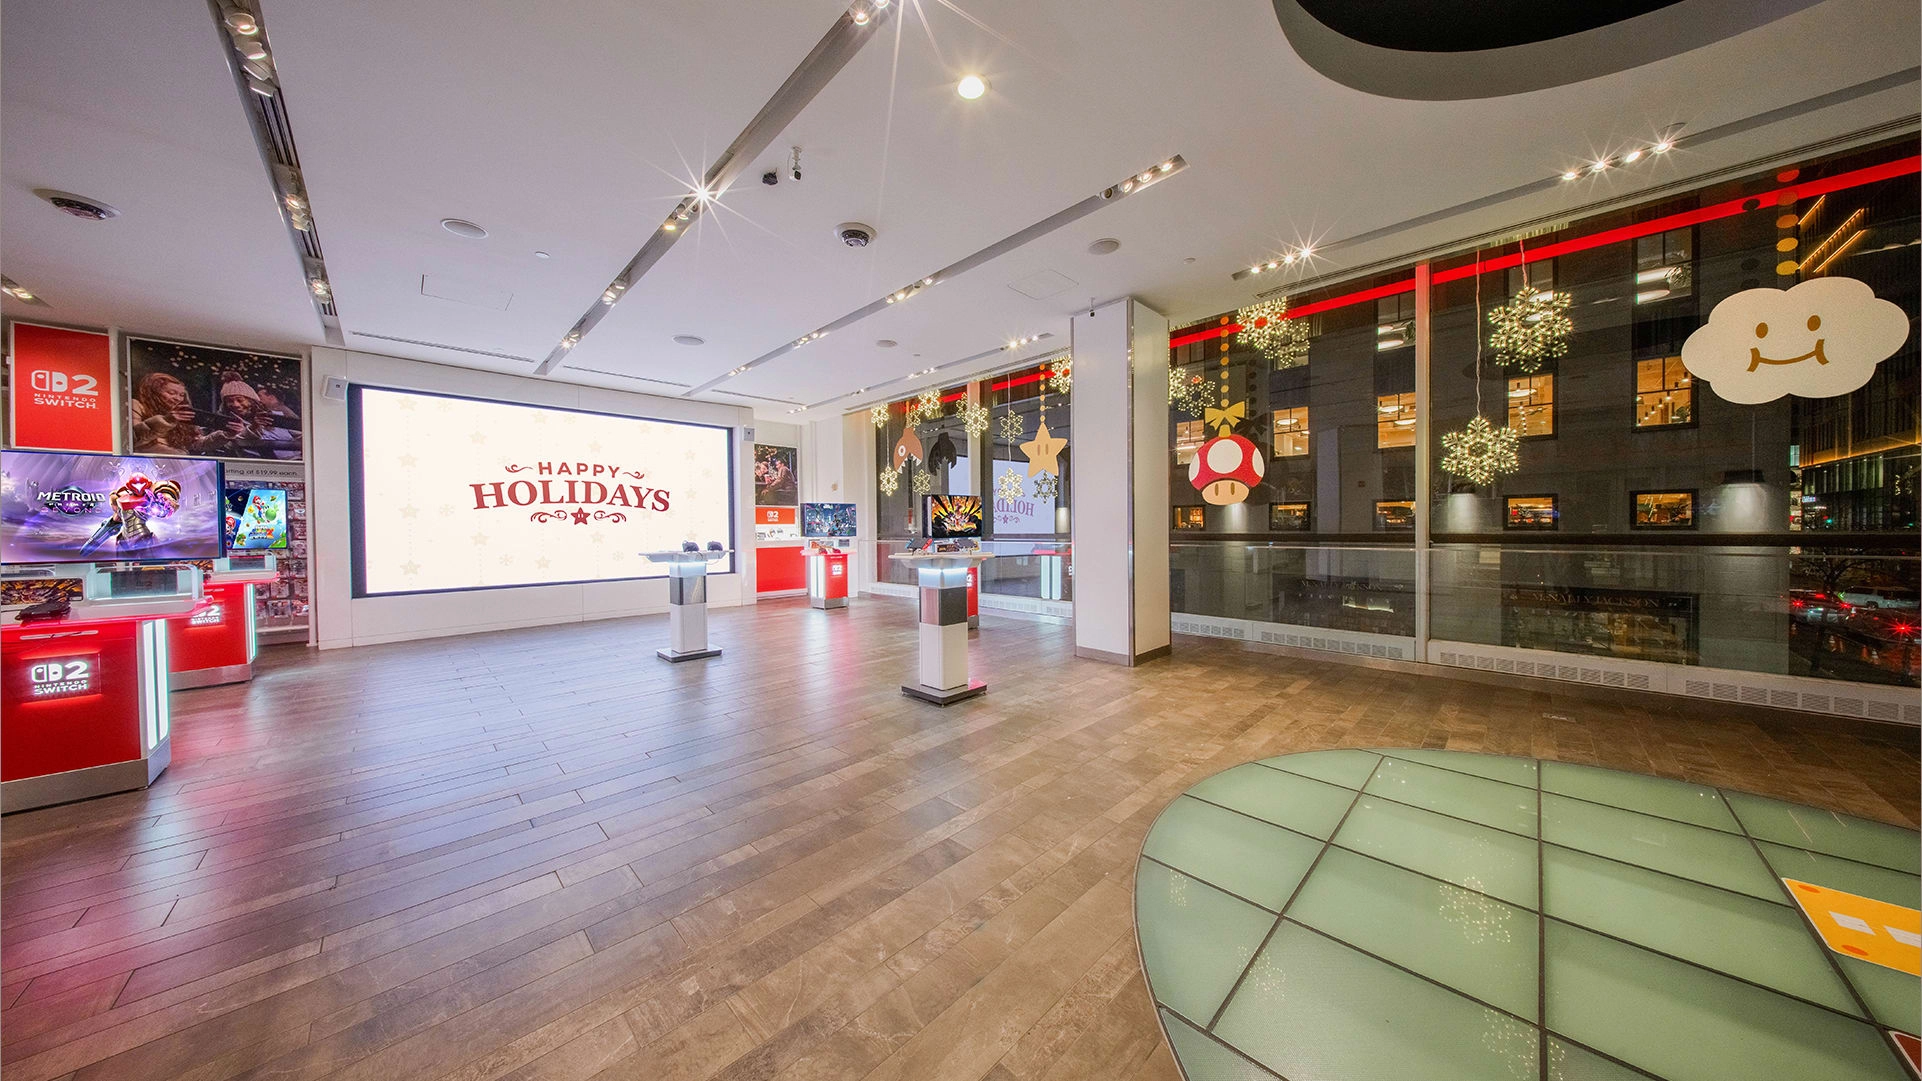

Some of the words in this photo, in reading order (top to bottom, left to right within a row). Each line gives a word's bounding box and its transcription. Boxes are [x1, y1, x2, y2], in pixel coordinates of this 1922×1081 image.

[72, 374, 98, 396] 2
[33, 393, 96, 402] NINTENDO
[33, 398, 97, 409] SWITCH
[538, 461, 620, 478] HAPPY
[36, 491, 105, 502] METROID
[469, 479, 670, 512] HOLIDAYS
[207, 605, 220, 616] 2
[64, 661, 89, 680] 2
[34, 679, 88, 688] NINTENDO
[34, 683, 88, 695] SWITCH
